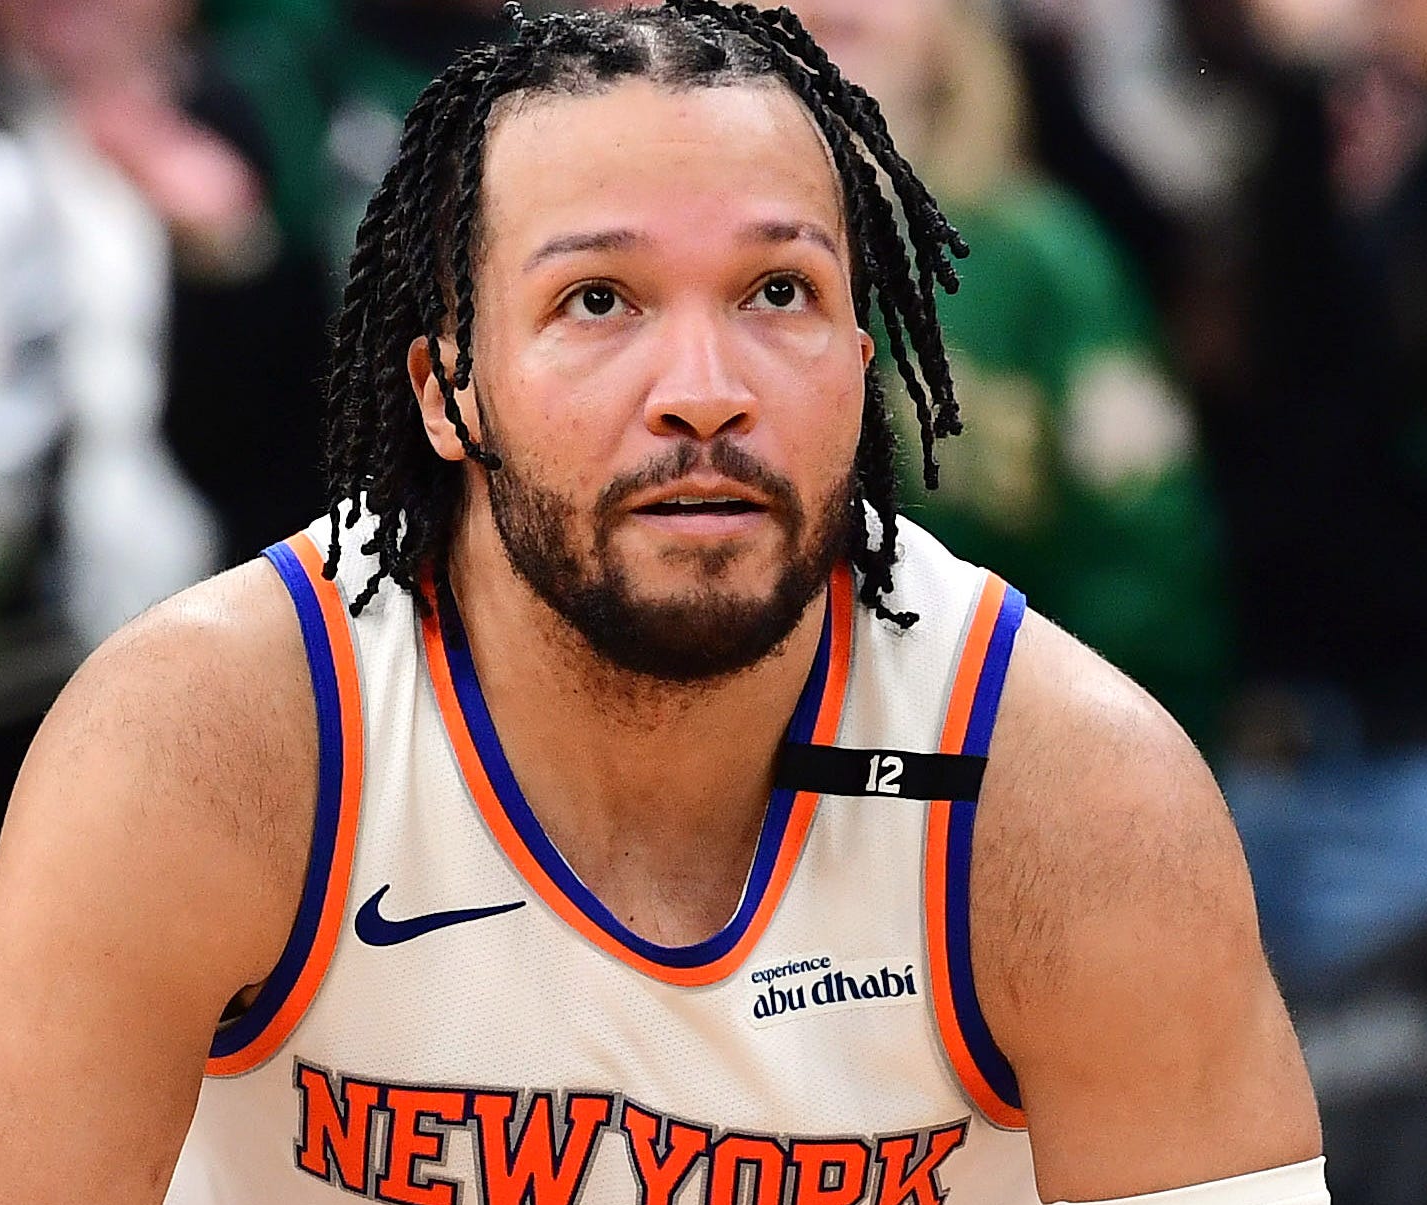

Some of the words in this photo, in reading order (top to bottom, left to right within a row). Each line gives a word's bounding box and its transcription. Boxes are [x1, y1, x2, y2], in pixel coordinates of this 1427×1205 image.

[865, 754, 904, 795] 12
[750, 955, 832, 985] experience
[753, 984, 807, 1019] abu
[811, 964, 918, 1006] dhabi
